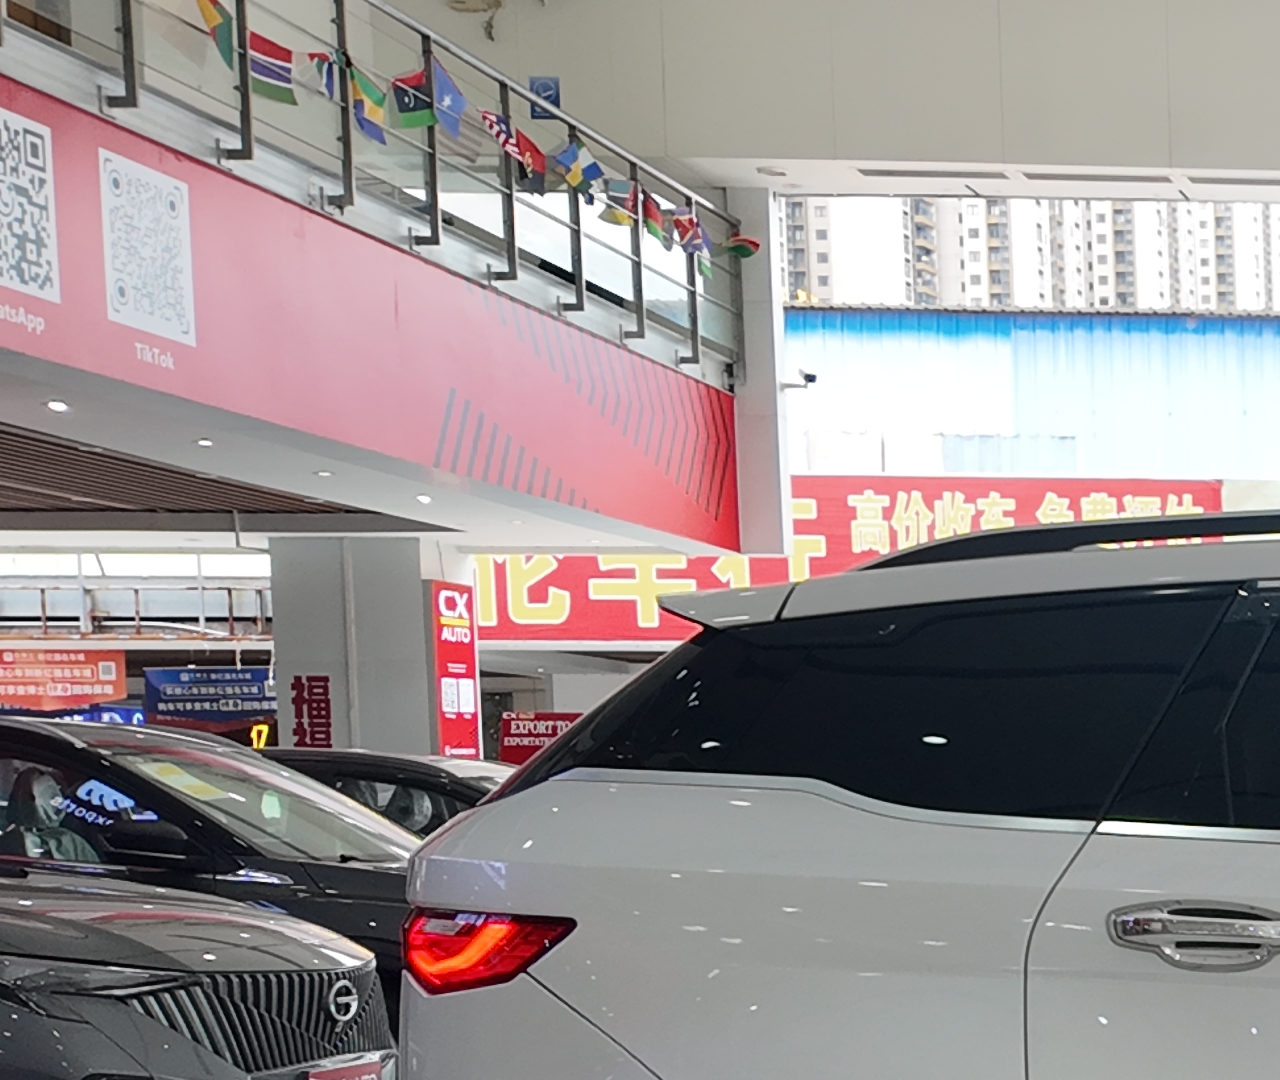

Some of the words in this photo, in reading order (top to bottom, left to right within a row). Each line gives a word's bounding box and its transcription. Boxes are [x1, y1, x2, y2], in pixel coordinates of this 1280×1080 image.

[134, 342, 175, 370] TikTok
[438, 590, 469, 618] CX
[441, 626, 471, 643] AUTO
[510, 721, 553, 734] EXPORT
